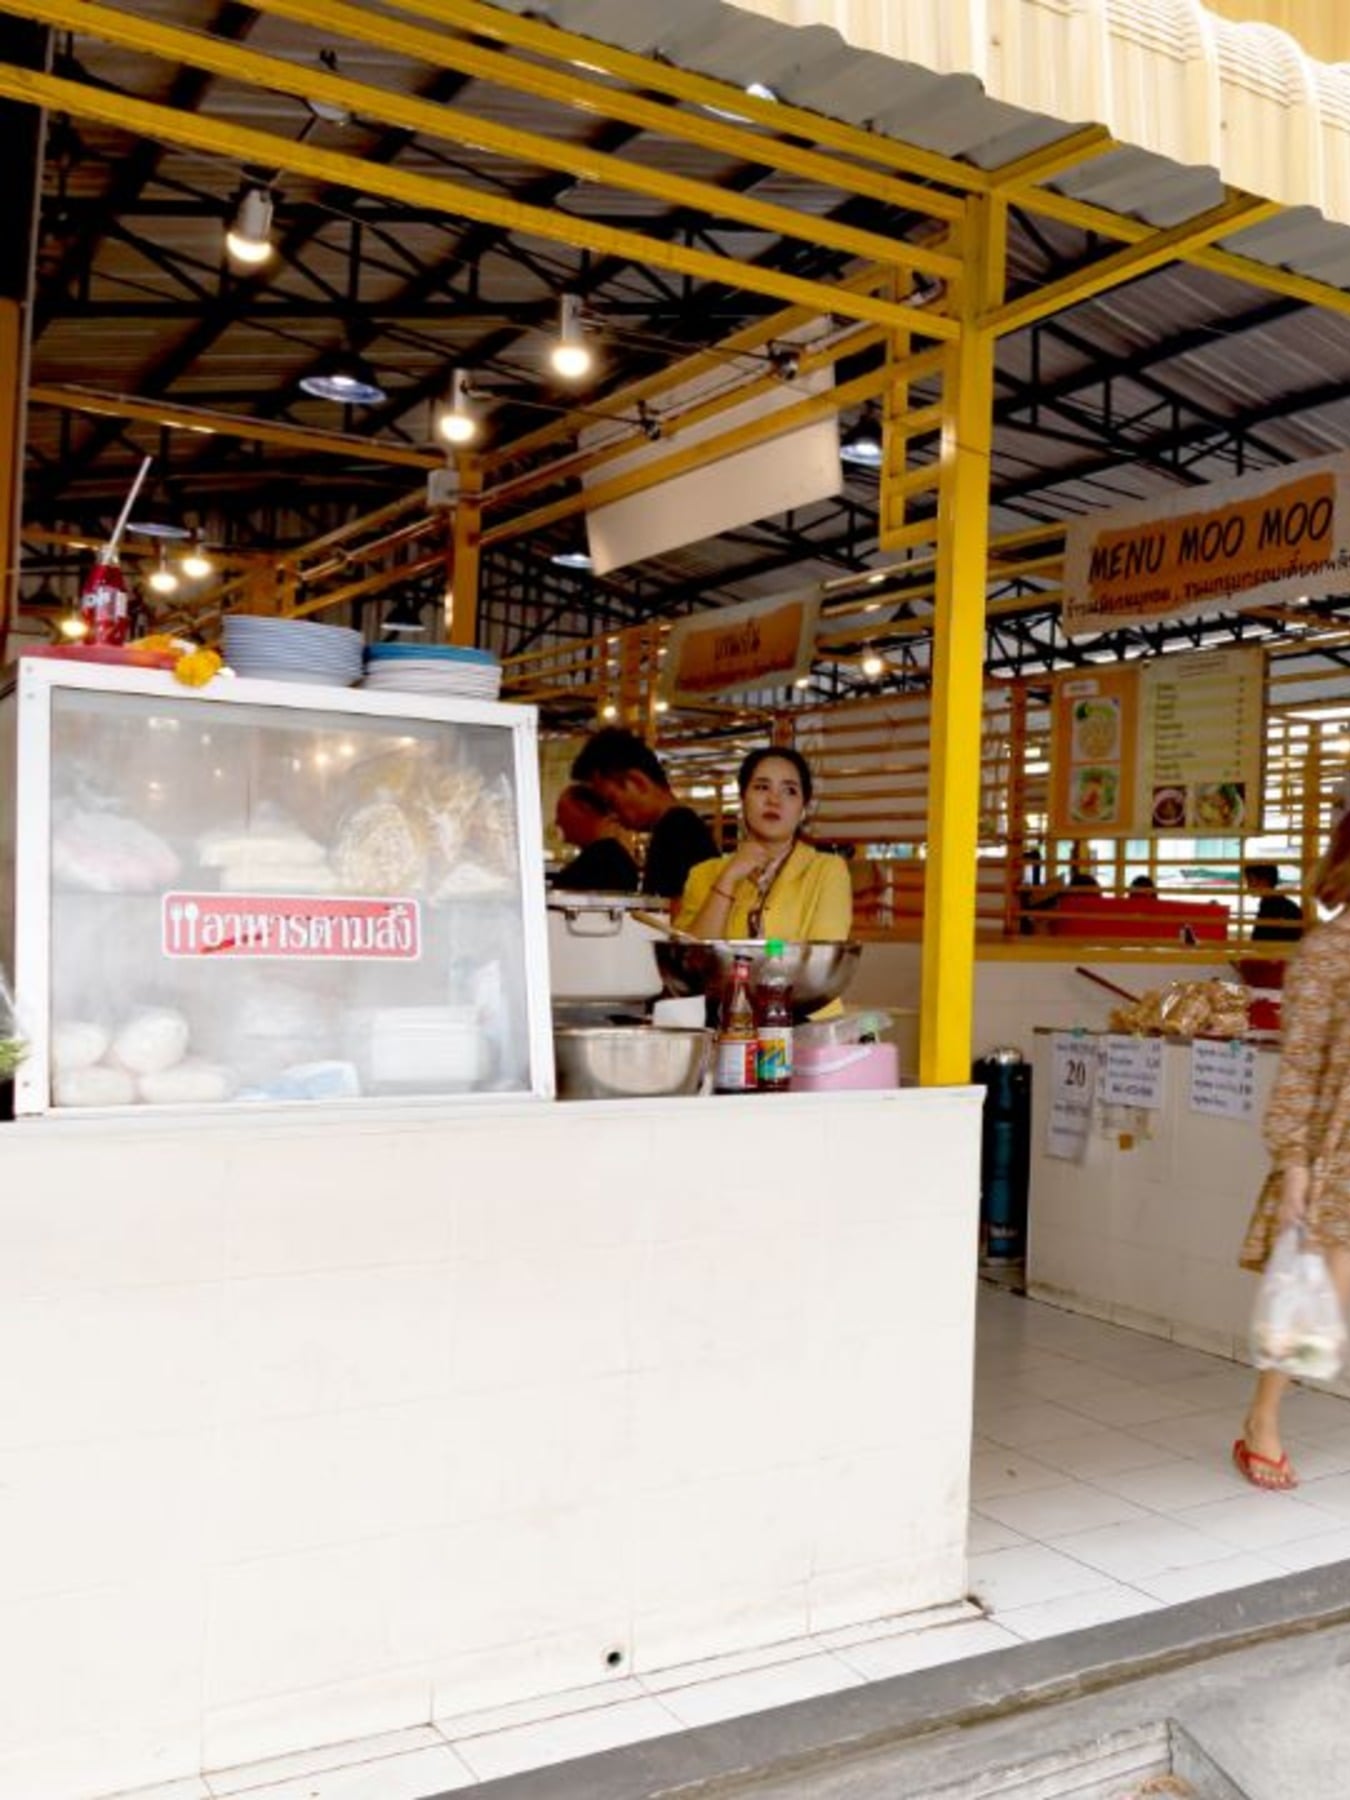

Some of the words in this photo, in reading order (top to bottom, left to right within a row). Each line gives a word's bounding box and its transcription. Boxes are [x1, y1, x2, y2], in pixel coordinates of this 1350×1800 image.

[1088, 535, 1165, 584] MENU
[1177, 517, 1245, 565] MOO
[1257, 497, 1334, 550] MOO
[202, 905, 411, 950] อาหารตามสั่ง
[1064, 1059, 1087, 1088] 20
